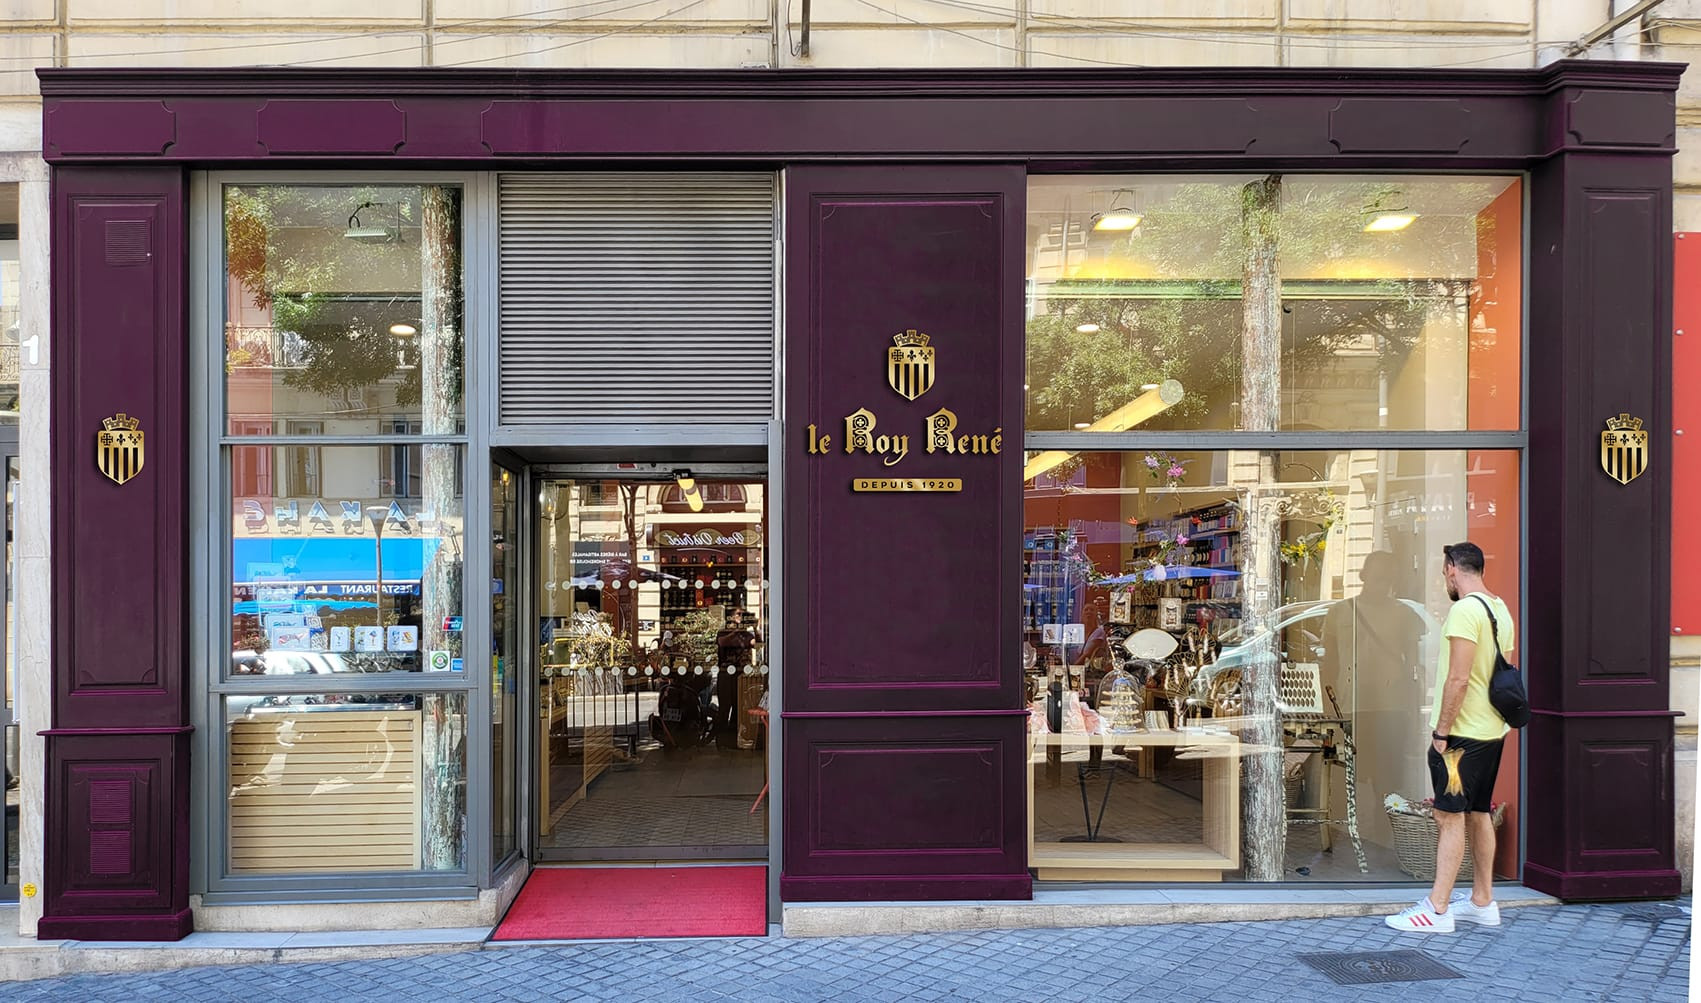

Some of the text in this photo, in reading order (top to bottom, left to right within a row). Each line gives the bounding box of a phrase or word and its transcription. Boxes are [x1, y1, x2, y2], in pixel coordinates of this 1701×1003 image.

[22, 334, 39, 365] 1
[807, 407, 1002, 466] le Roy René
[861, 481, 955, 489] DEPUIS 1920
